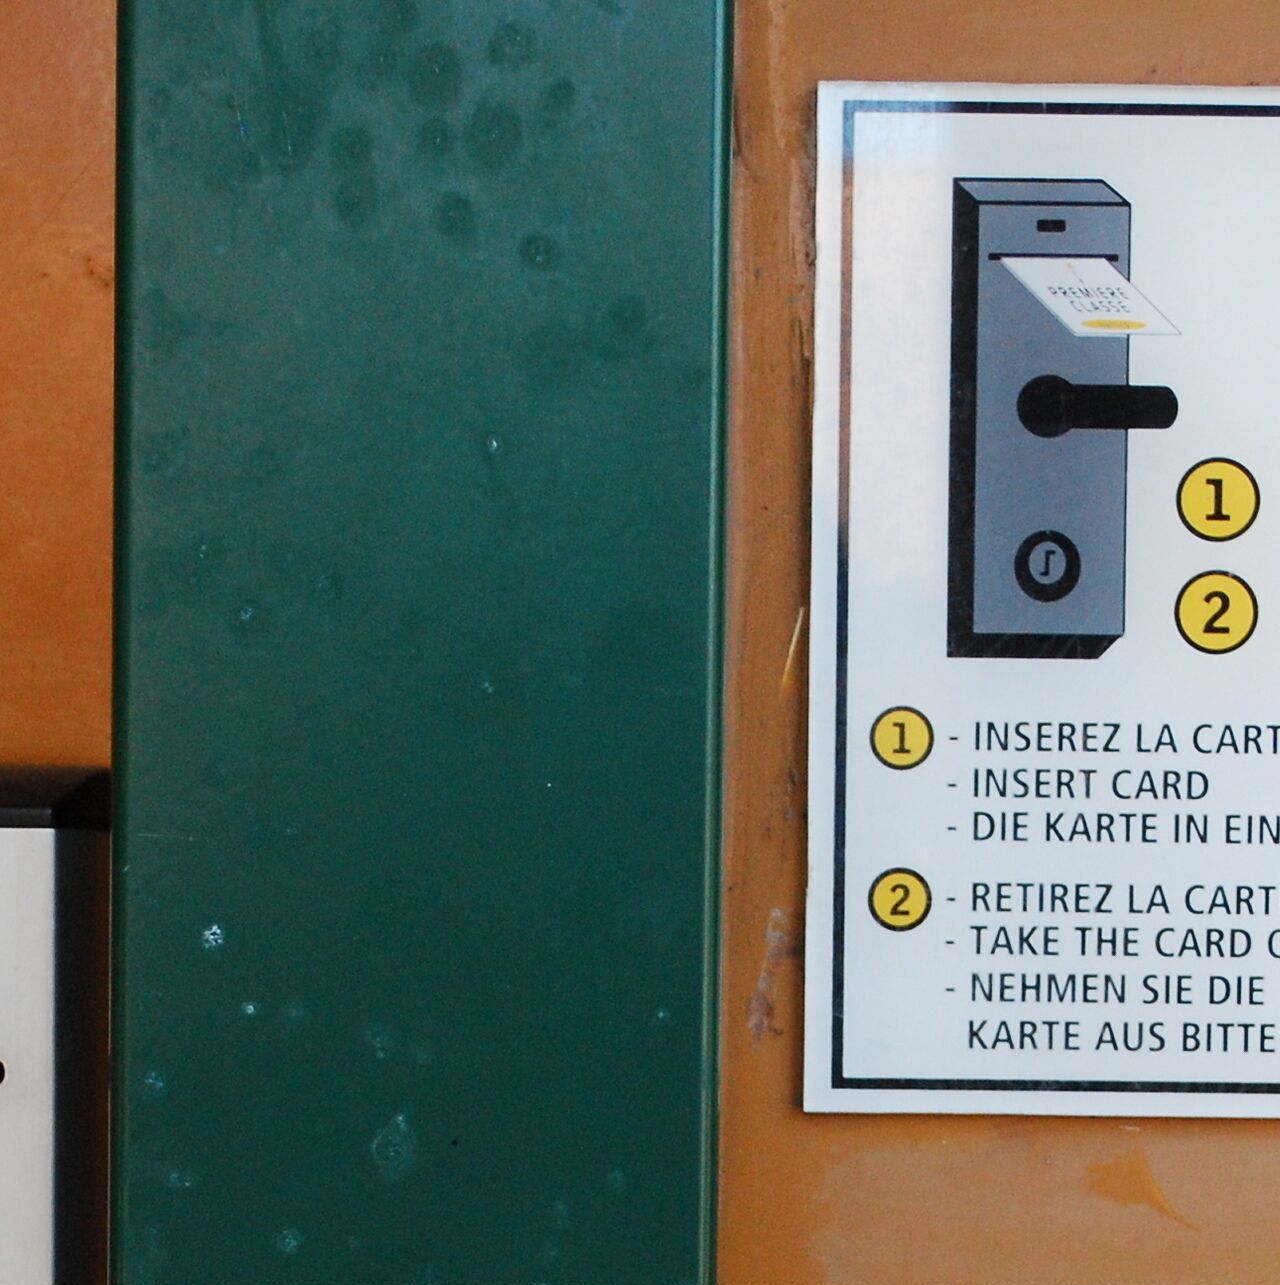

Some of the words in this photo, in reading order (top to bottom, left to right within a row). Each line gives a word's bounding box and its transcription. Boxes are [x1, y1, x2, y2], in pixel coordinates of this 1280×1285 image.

[1048, 286, 1129, 300] PREMIERE
[1070, 300, 1131, 313] CLASSE
[1205, 478, 1230, 521] 1
[1202, 591, 1230, 634] 2
[892, 722, 911, 754] 1
[975, 722, 1120, 752] INSEREZ
[1137, 723, 1178, 753] LA
[974, 768, 1097, 799] INSERT
[1112, 770, 1209, 800] CARD
[973, 811, 1028, 841] DIE
[1046, 812, 1157, 843] KARTE
[1174, 814, 1208, 843] IN
[1225, 815, 1280, 844] EIN
[889, 883, 910, 916] 2
[972, 882, 1113, 913] RETIREZ
[1129, 884, 1170, 914] LA
[970, 925, 1059, 956] TAKE
[1074, 927, 1139, 956] THE
[1155, 927, 1252, 958] CARD
[972, 973, 1125, 1003] NEHMEN
[1142, 974, 1192, 1004] SIE
[1209, 976, 1264, 1005] DIE
[968, 1020, 1080, 1050] KARTE
[1095, 1022, 1165, 1052] AUS
[1182, 1022, 1275, 1053] BITTE
